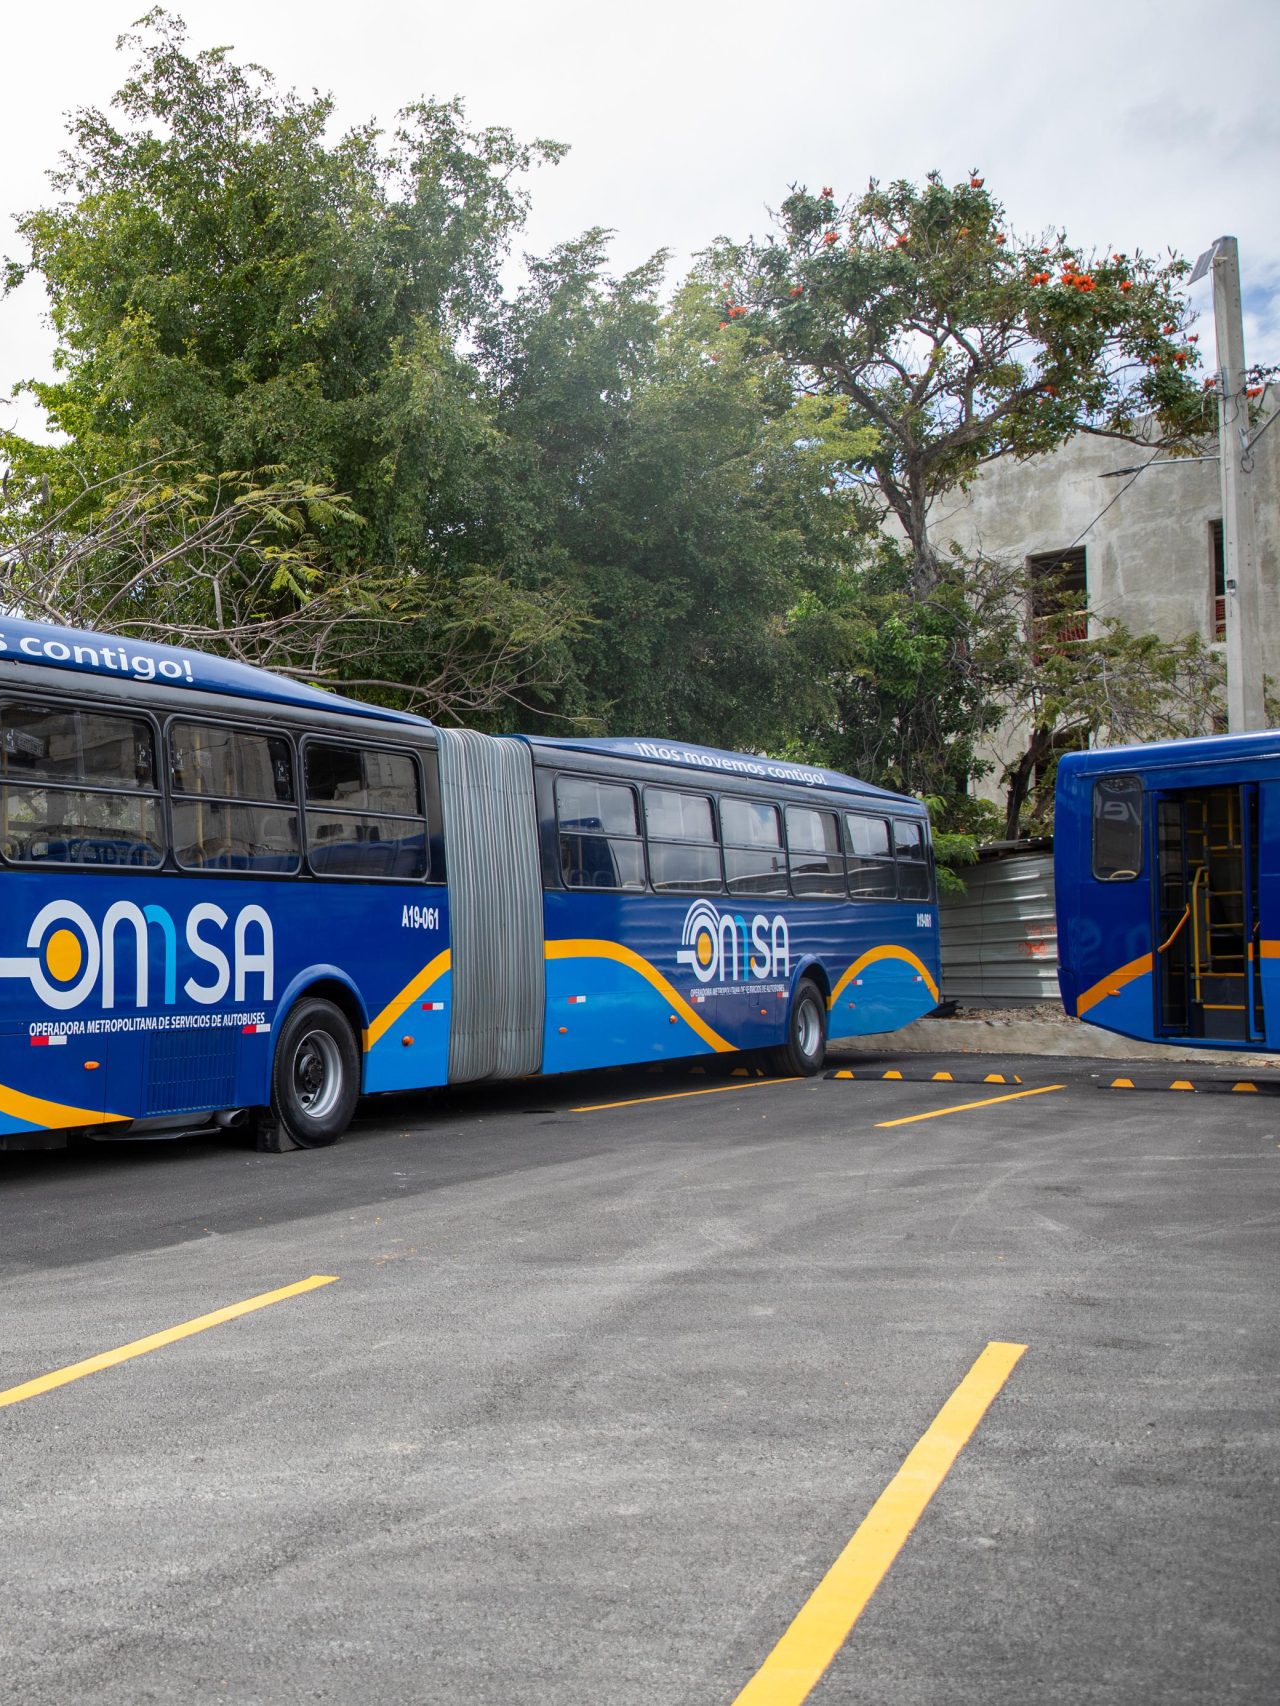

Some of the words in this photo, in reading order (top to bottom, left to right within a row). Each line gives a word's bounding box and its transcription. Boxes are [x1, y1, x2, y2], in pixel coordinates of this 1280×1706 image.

[19, 636, 195, 683] contigo!
[683, 751, 766, 776] movemos
[768, 766, 829, 786] contigo!
[402, 904, 439, 930] A19-061
[29, 1022, 86, 1037] OPERADORA
[86, 1016, 158, 1034] METROPOLITANA
[158, 1016, 170, 1029] DE
[171, 1014, 211, 1029] SERVICIOS
[211, 1014, 222, 1026] DE
[223, 1012, 265, 1027] AUTOBUSES
